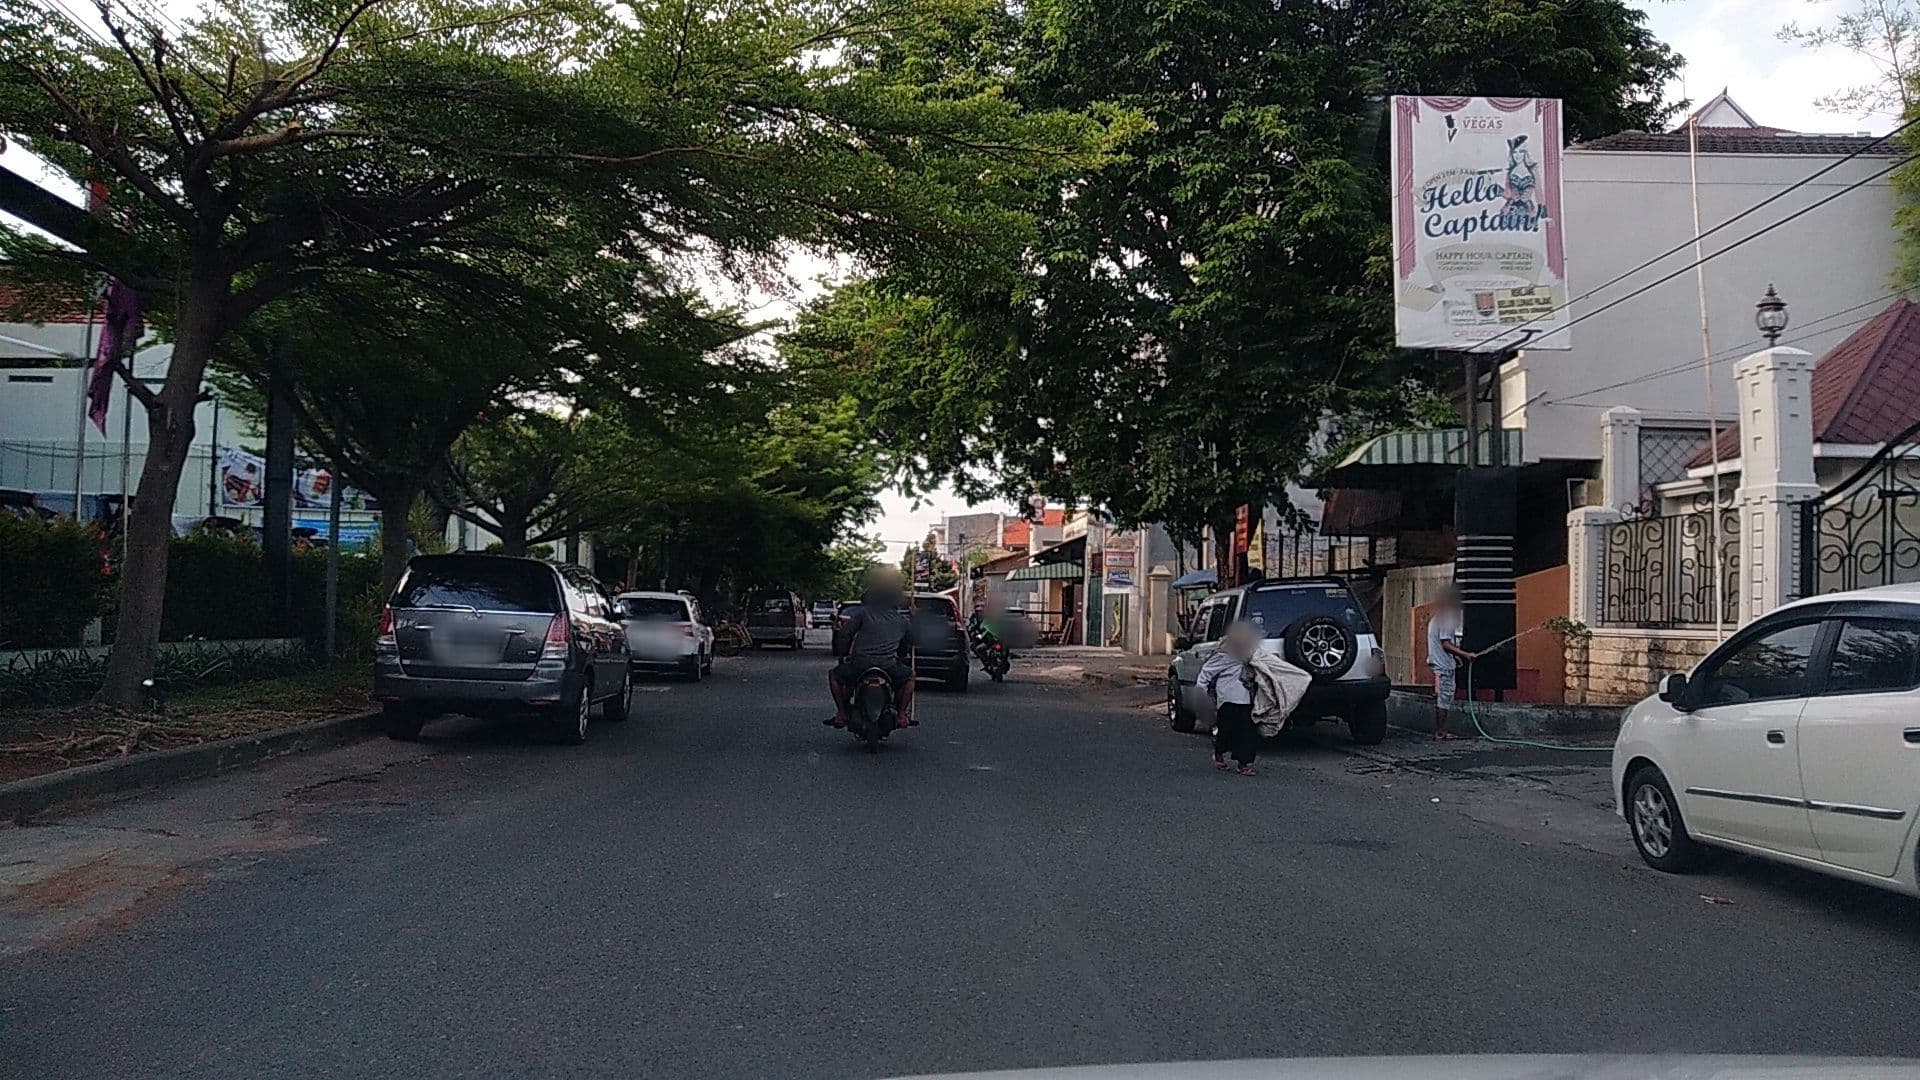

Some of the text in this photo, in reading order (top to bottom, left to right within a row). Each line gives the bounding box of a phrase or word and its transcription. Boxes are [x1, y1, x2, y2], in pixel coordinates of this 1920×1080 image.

[1463, 119, 1503, 129] VEGAS
[1420, 175, 1501, 213] Hello
[1435, 252, 1464, 260] HAPPY
[1495, 251, 1533, 260] CAPTAIN
